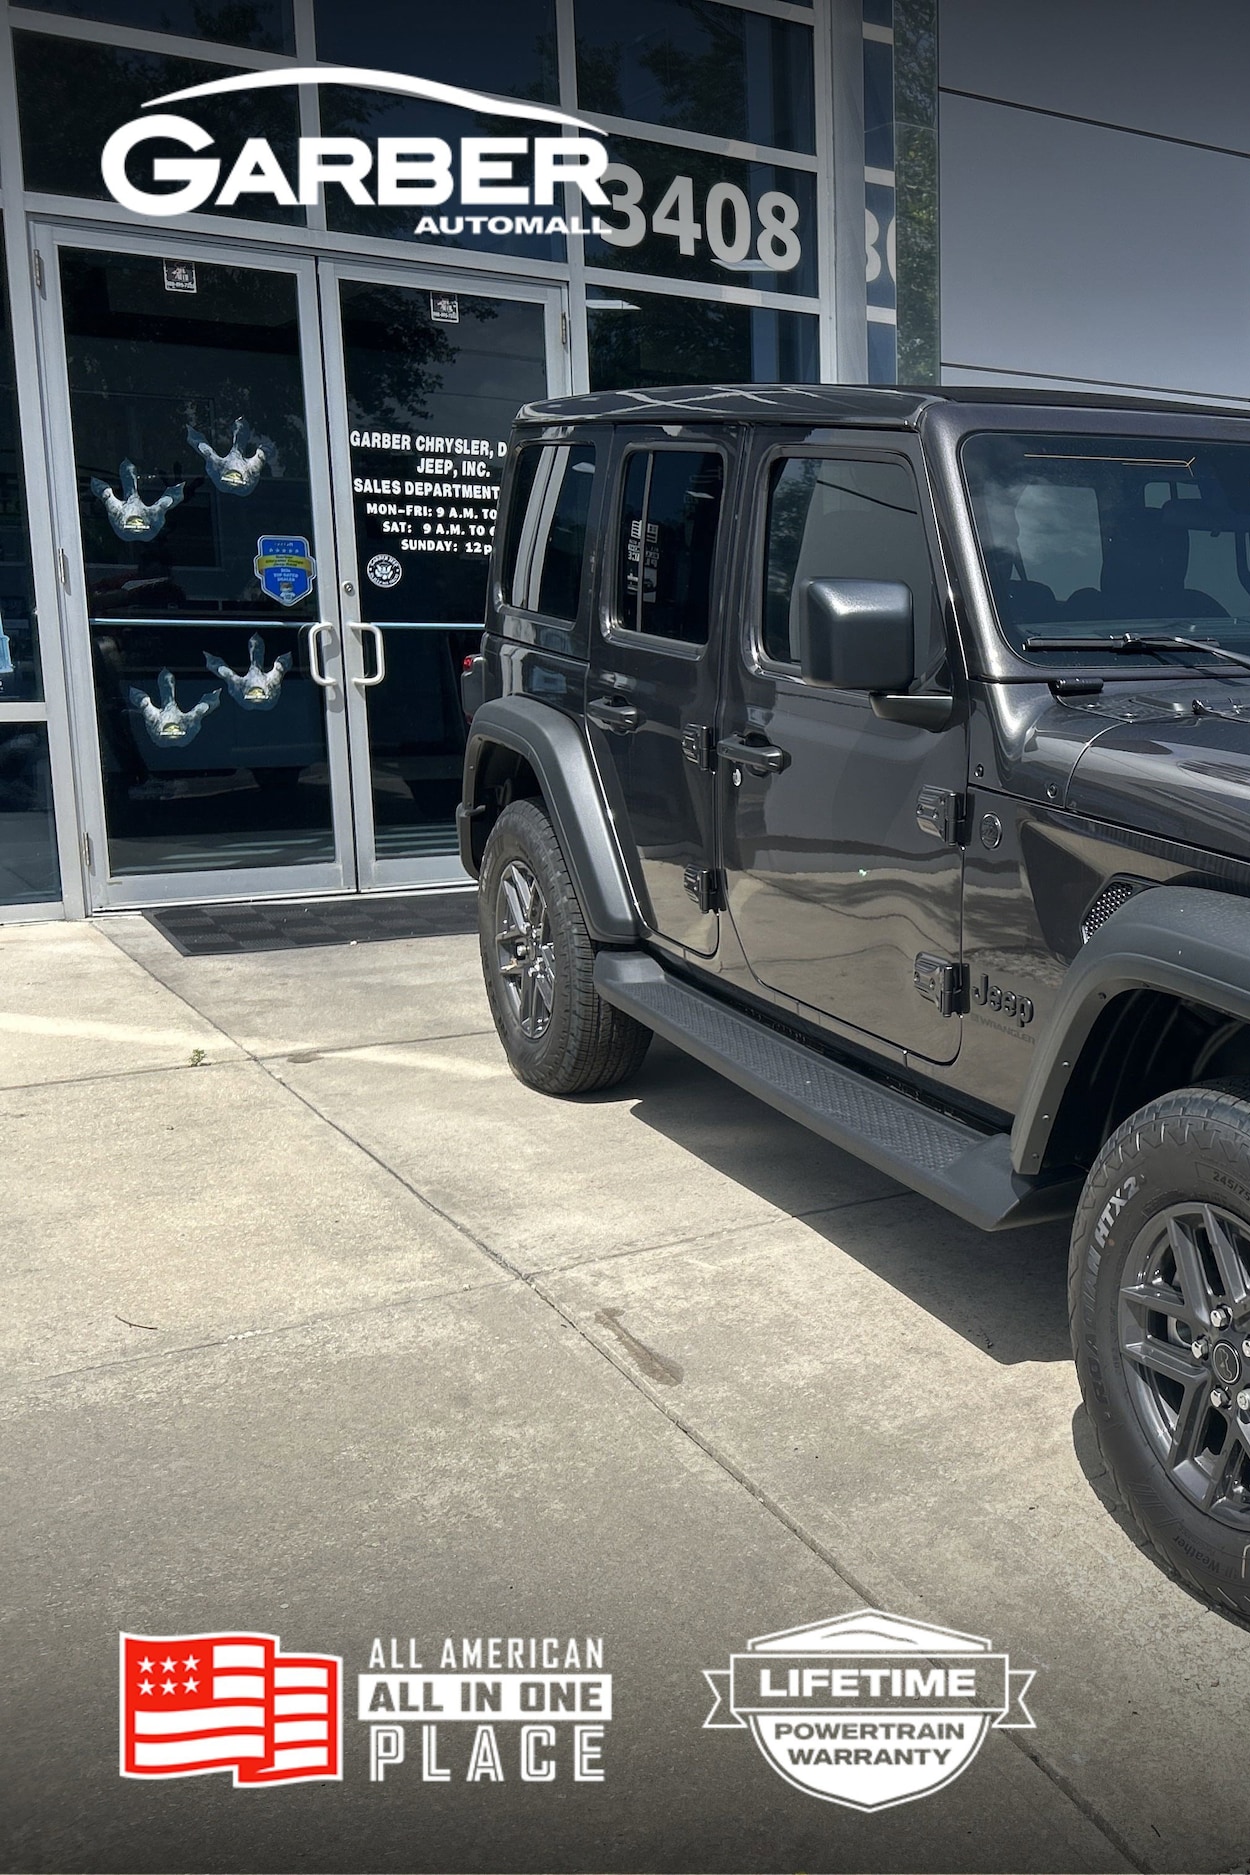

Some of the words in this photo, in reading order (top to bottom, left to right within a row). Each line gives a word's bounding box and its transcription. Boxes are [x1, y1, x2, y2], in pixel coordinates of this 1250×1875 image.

[600, 162, 802, 272] 3408
[350, 430, 411, 450] GARBER
[415, 435, 494, 459] CHRYSLER,
[416, 457, 458, 479] JEEP,
[461, 460, 491, 478] INC.
[353, 478, 401, 495] SALES
[404, 481, 500, 500] DEPARTMENT
[366, 503, 433, 518] MON-FRI:
[436, 506, 445, 518] 9
[448, 506, 479, 520] A.M.
[481, 508, 498, 520] TO
[382, 521, 412, 534] SAT:
[423, 523, 432, 535] 9
[435, 523, 466, 536] A.M.
[468, 524, 486, 536] TO
[401, 539, 458, 553] SUNDAY:
[465, 541, 493, 555] 12p
[972, 973, 1034, 1028] Jeep
